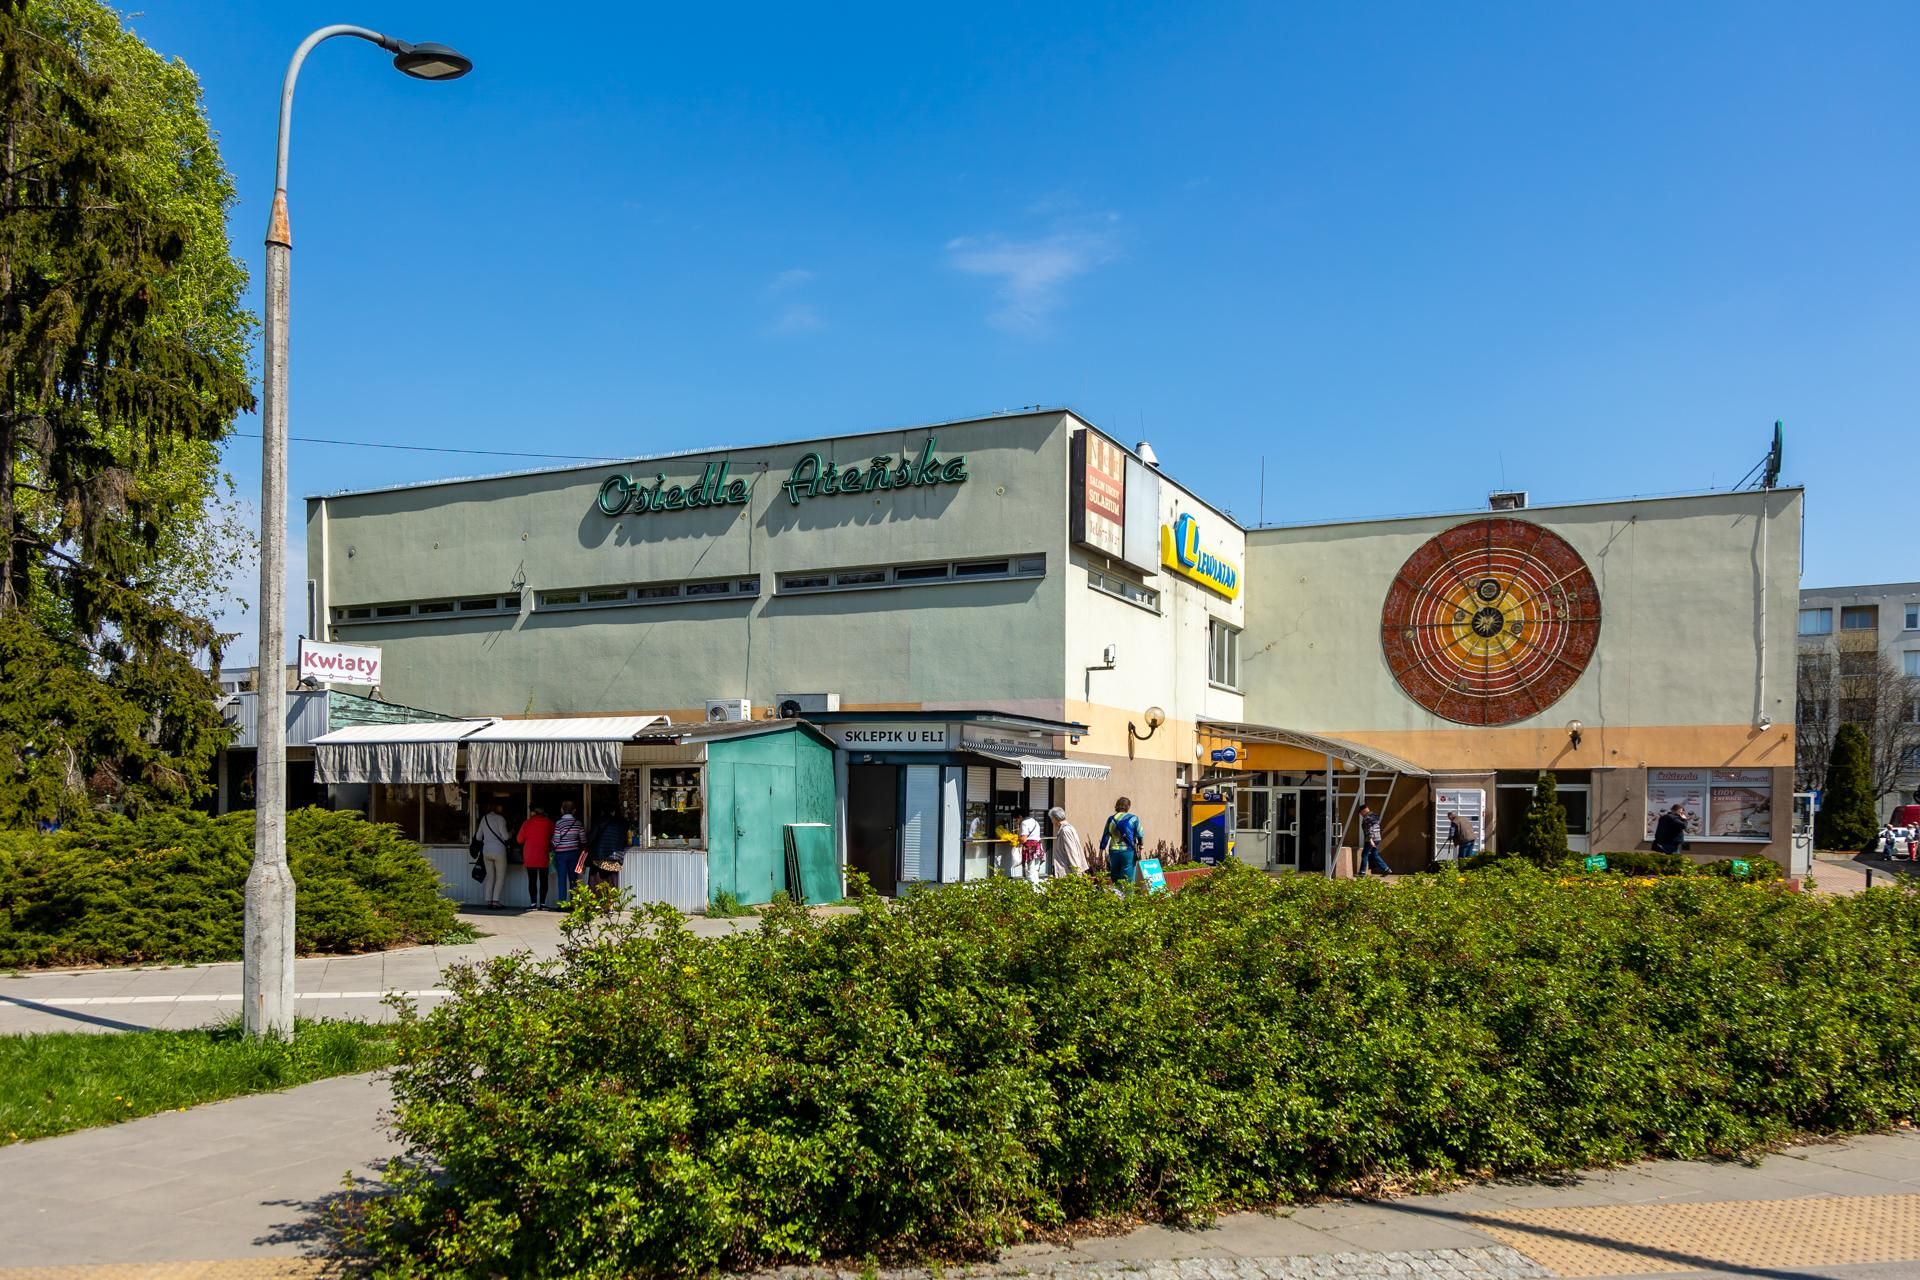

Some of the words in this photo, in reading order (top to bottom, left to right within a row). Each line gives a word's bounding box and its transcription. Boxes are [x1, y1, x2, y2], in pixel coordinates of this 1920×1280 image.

[598, 460, 750, 516] Osiedle
[1089, 489, 1120, 516] SOLARIUM
[1197, 550, 1236, 590] LEWIATAN
[304, 651, 378, 676] Kwiaty
[845, 731, 903, 743] SKLEPIK
[907, 731, 917, 743] U
[921, 731, 944, 743] ELI
